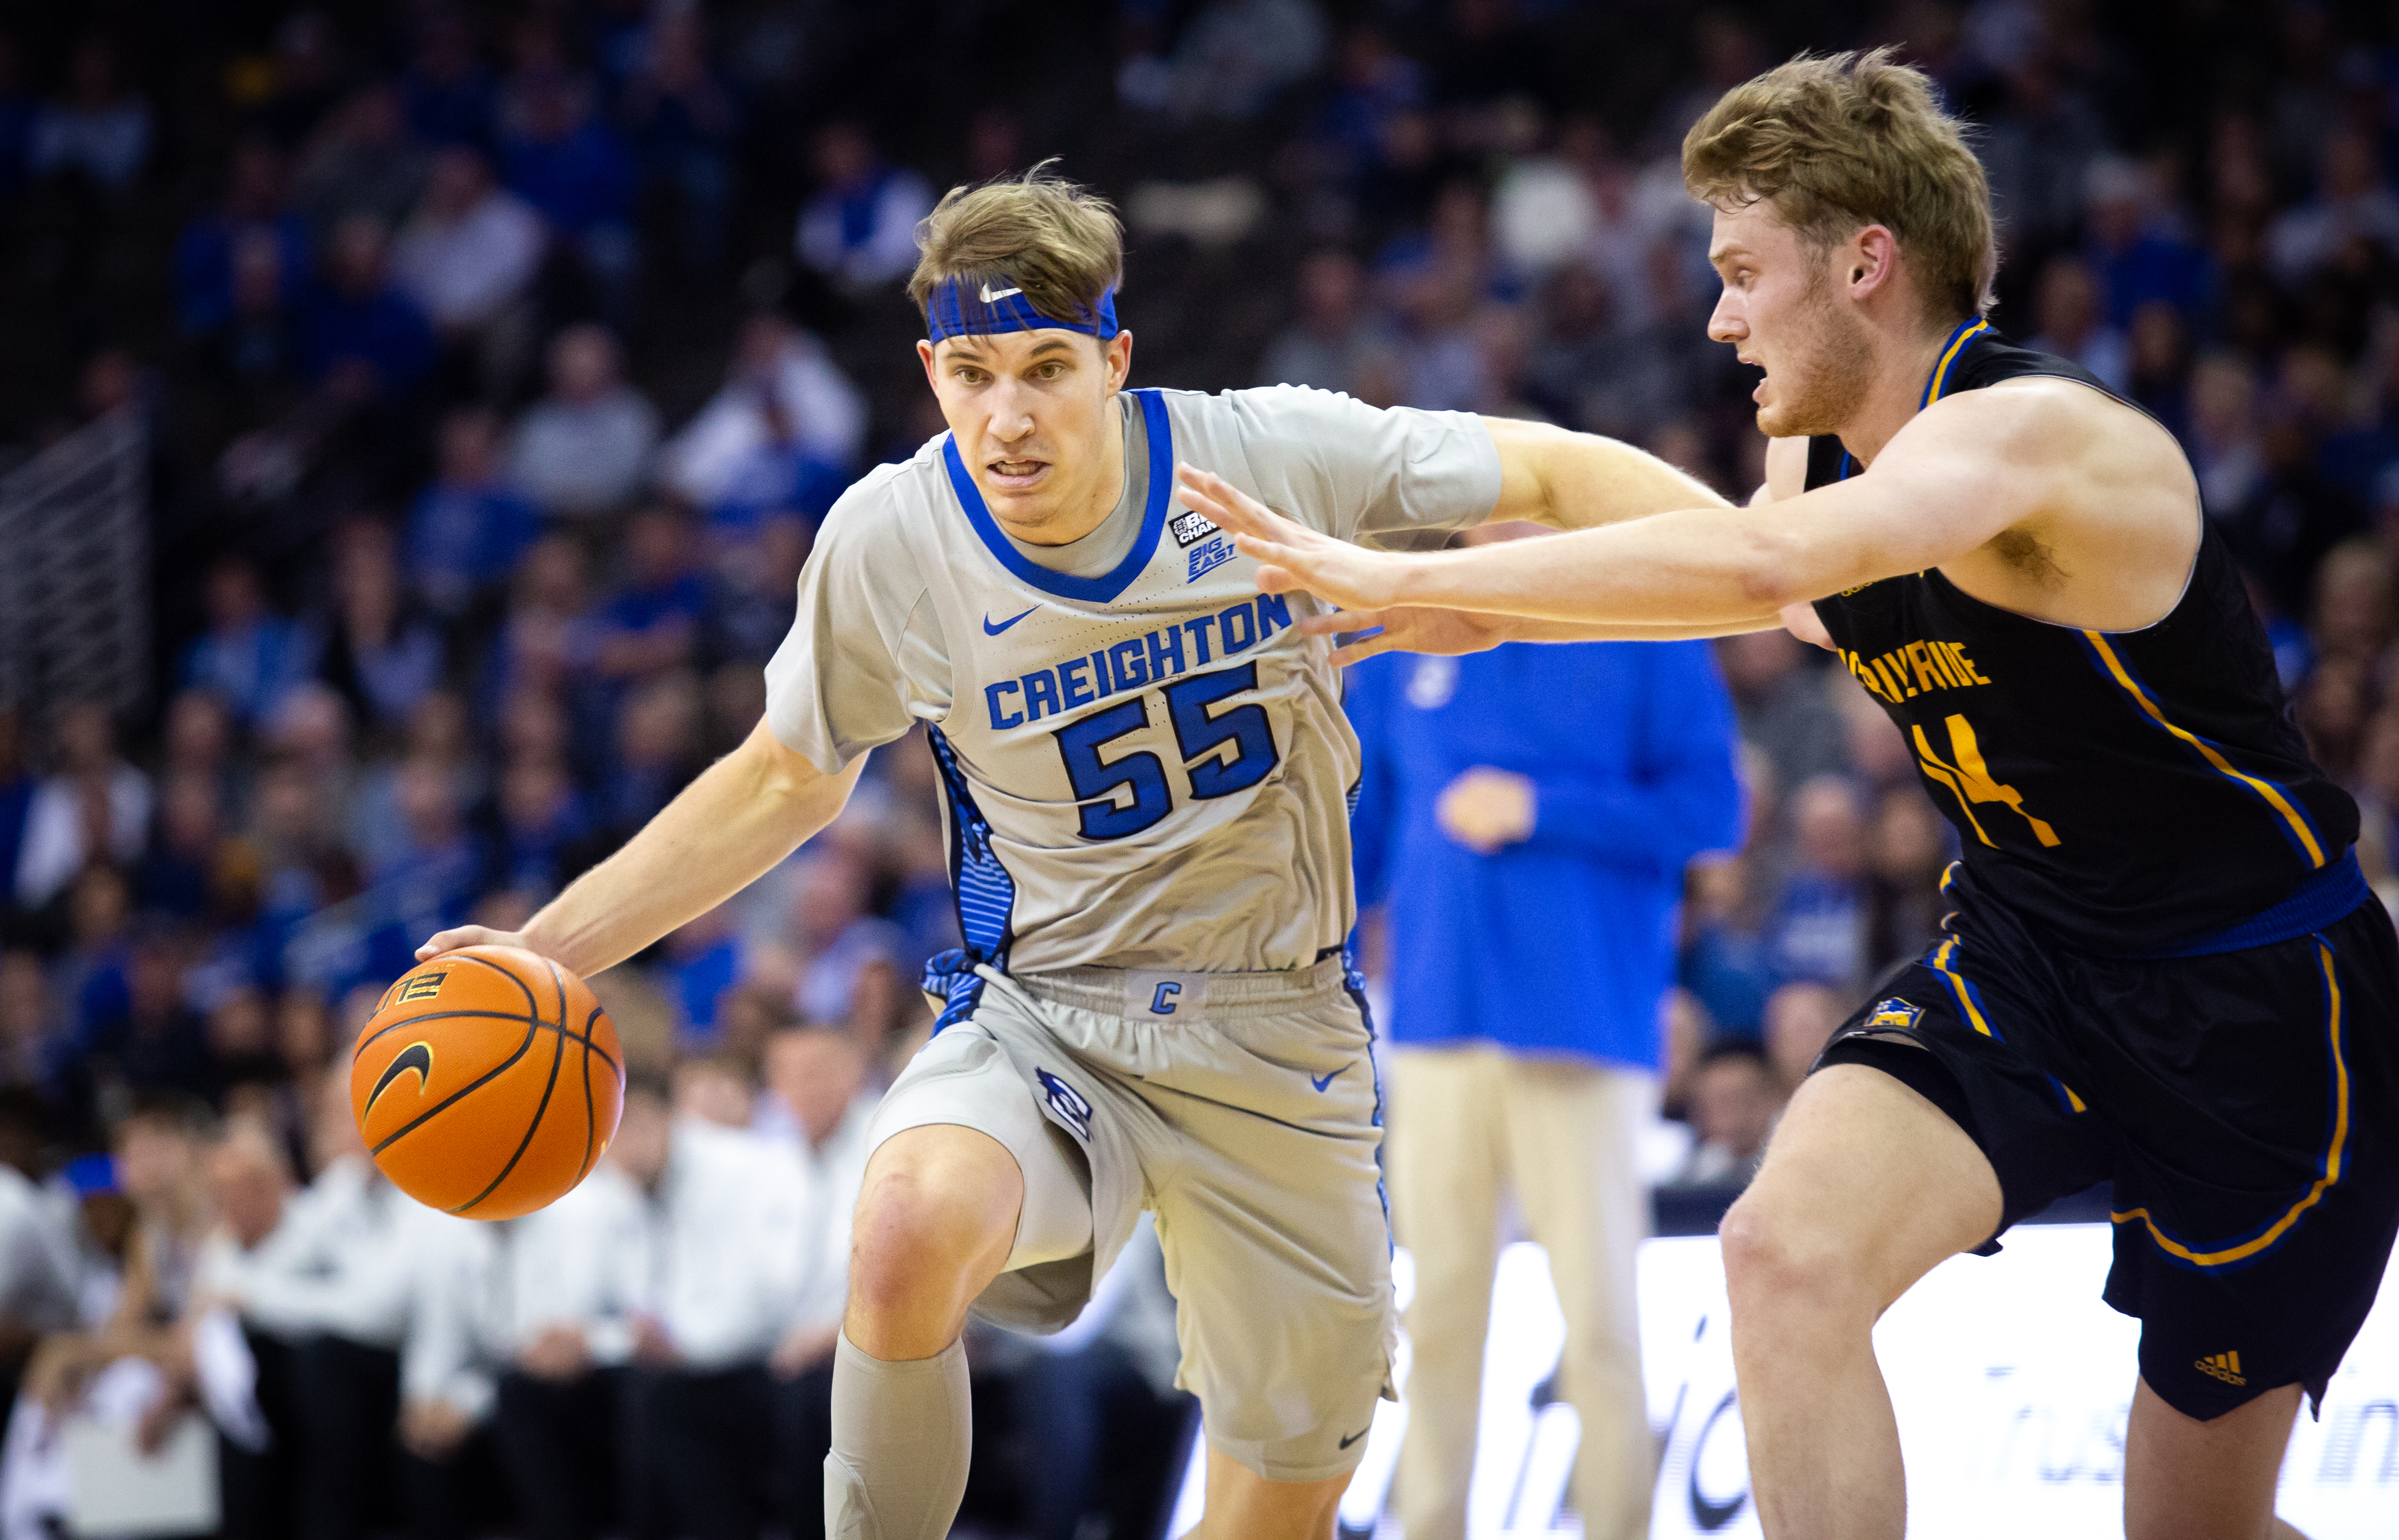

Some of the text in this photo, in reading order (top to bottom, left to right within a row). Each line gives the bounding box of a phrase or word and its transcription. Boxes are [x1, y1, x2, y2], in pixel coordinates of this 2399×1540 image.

[1189, 536, 1223, 563] BIG
[1189, 544, 1235, 576] EAST
[984, 593, 1293, 730] CREIGHTON
[1050, 660, 1280, 841] 55
[1149, 981, 1182, 1014] C
[2194, 1360, 2246, 1386] adidas
